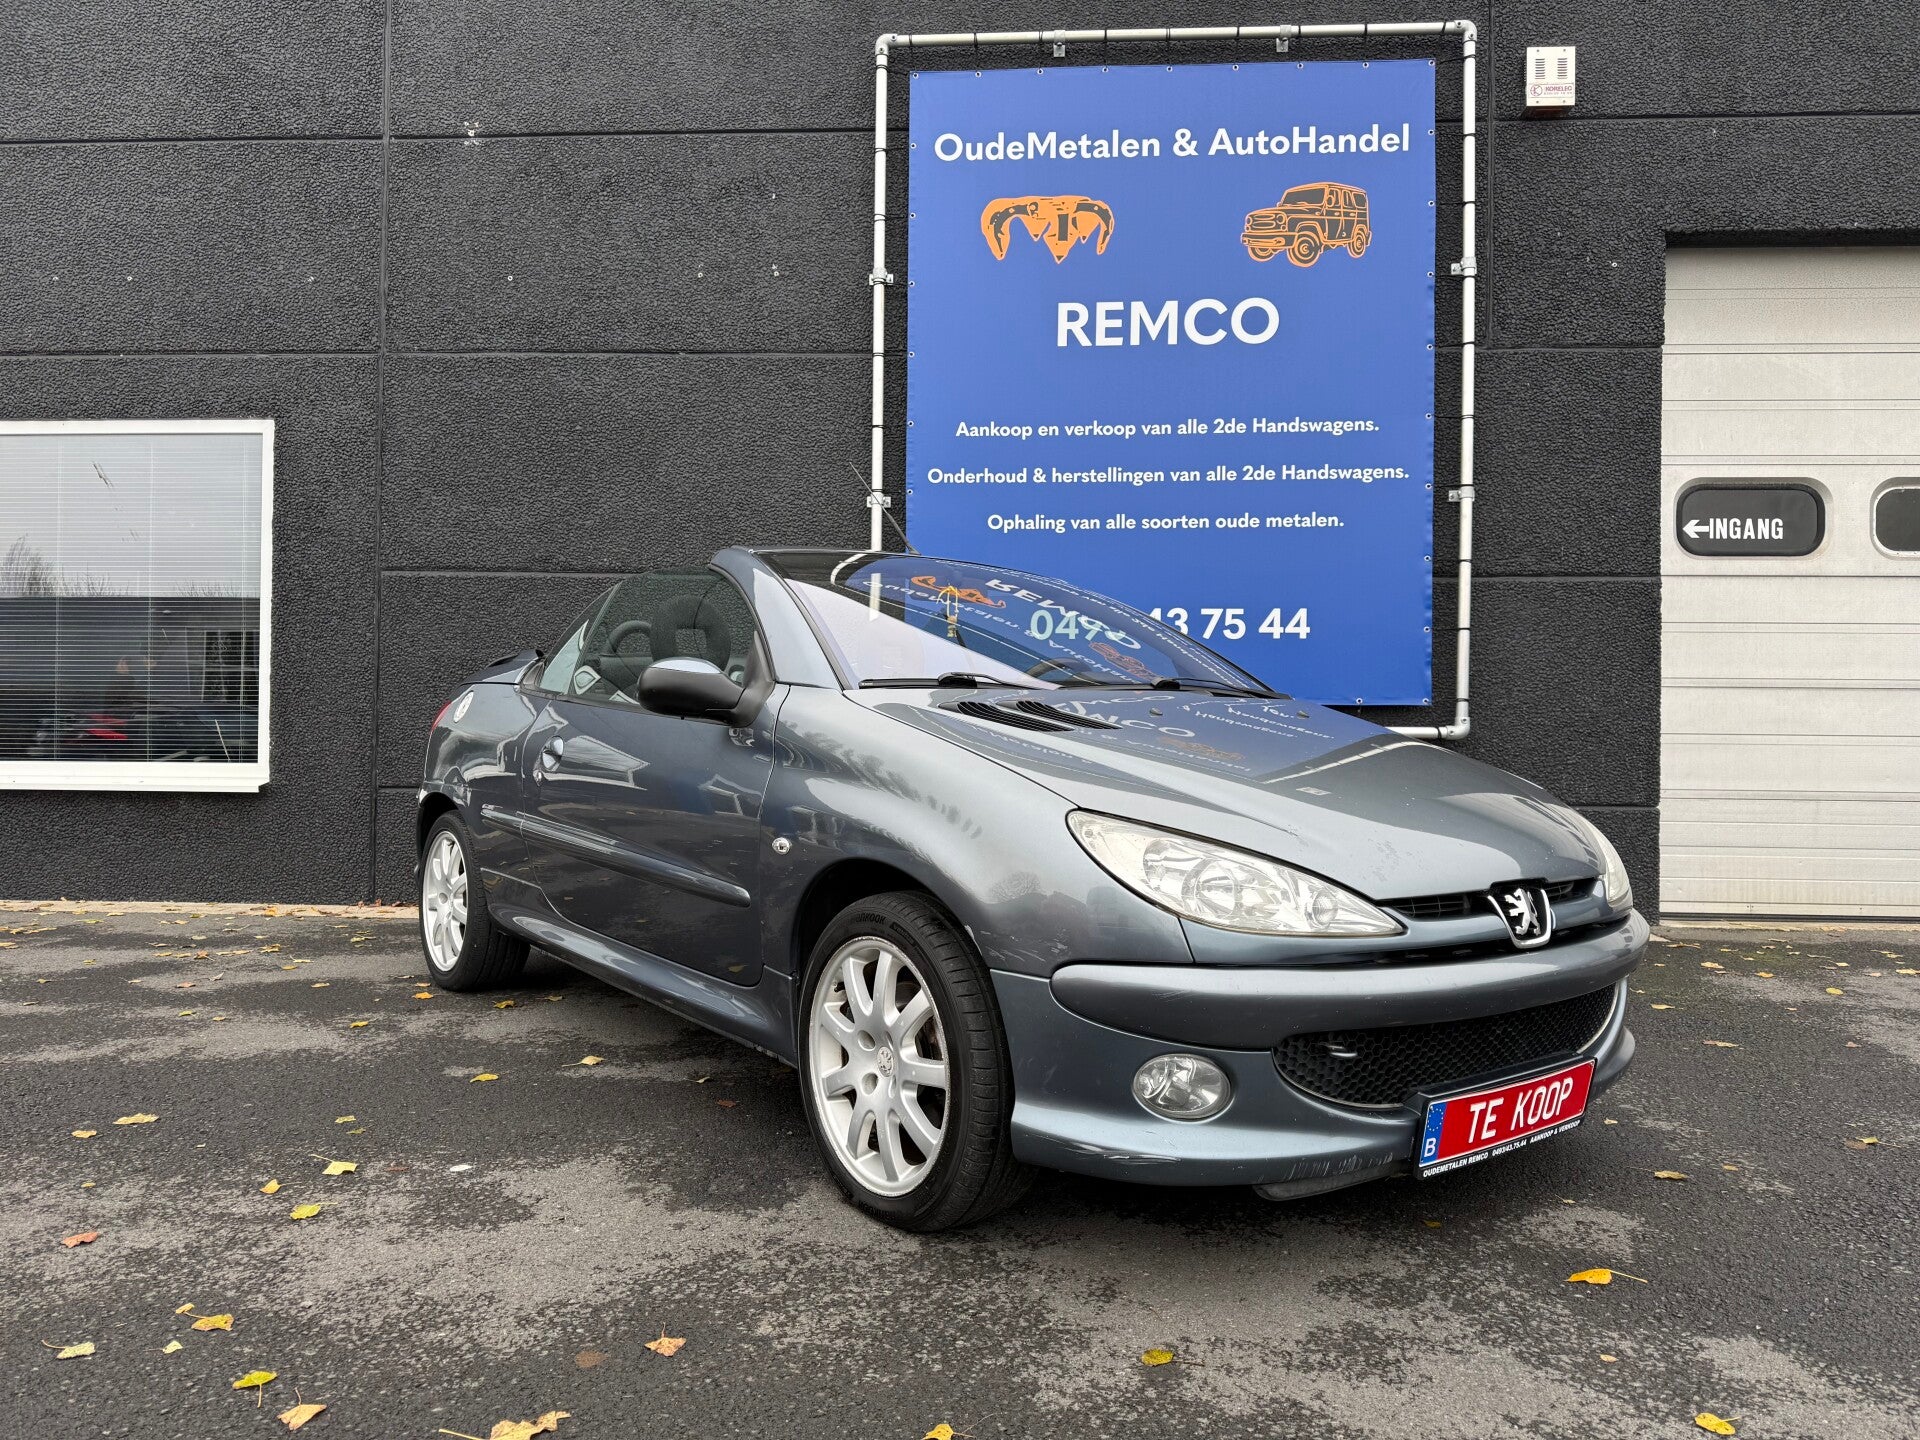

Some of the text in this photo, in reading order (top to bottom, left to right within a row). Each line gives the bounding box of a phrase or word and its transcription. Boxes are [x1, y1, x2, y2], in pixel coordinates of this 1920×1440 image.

[934, 122, 1411, 162] OudeMetalen & AutoHandel
[1056, 297, 1280, 347] REMCO
[955, 416, 1380, 440] Aankoop en verkoop van alle 2de Handswagens.
[927, 463, 1410, 487] Onderhoud & herstellingen van alle 2de Handswagens.
[987, 511, 1345, 534] Ophaling van alle soorten oude metalen.
[1709, 517, 1784, 540] INGANG
[1200, 608, 1246, 640] 75
[1257, 607, 1311, 640] 44
[1468, 1077, 1573, 1144] TE KOOP
[1423, 1137, 1437, 1158] B
[1423, 1158, 1468, 1178] OUDEMETALEN
[1468, 1152, 1489, 1164] REMCO
